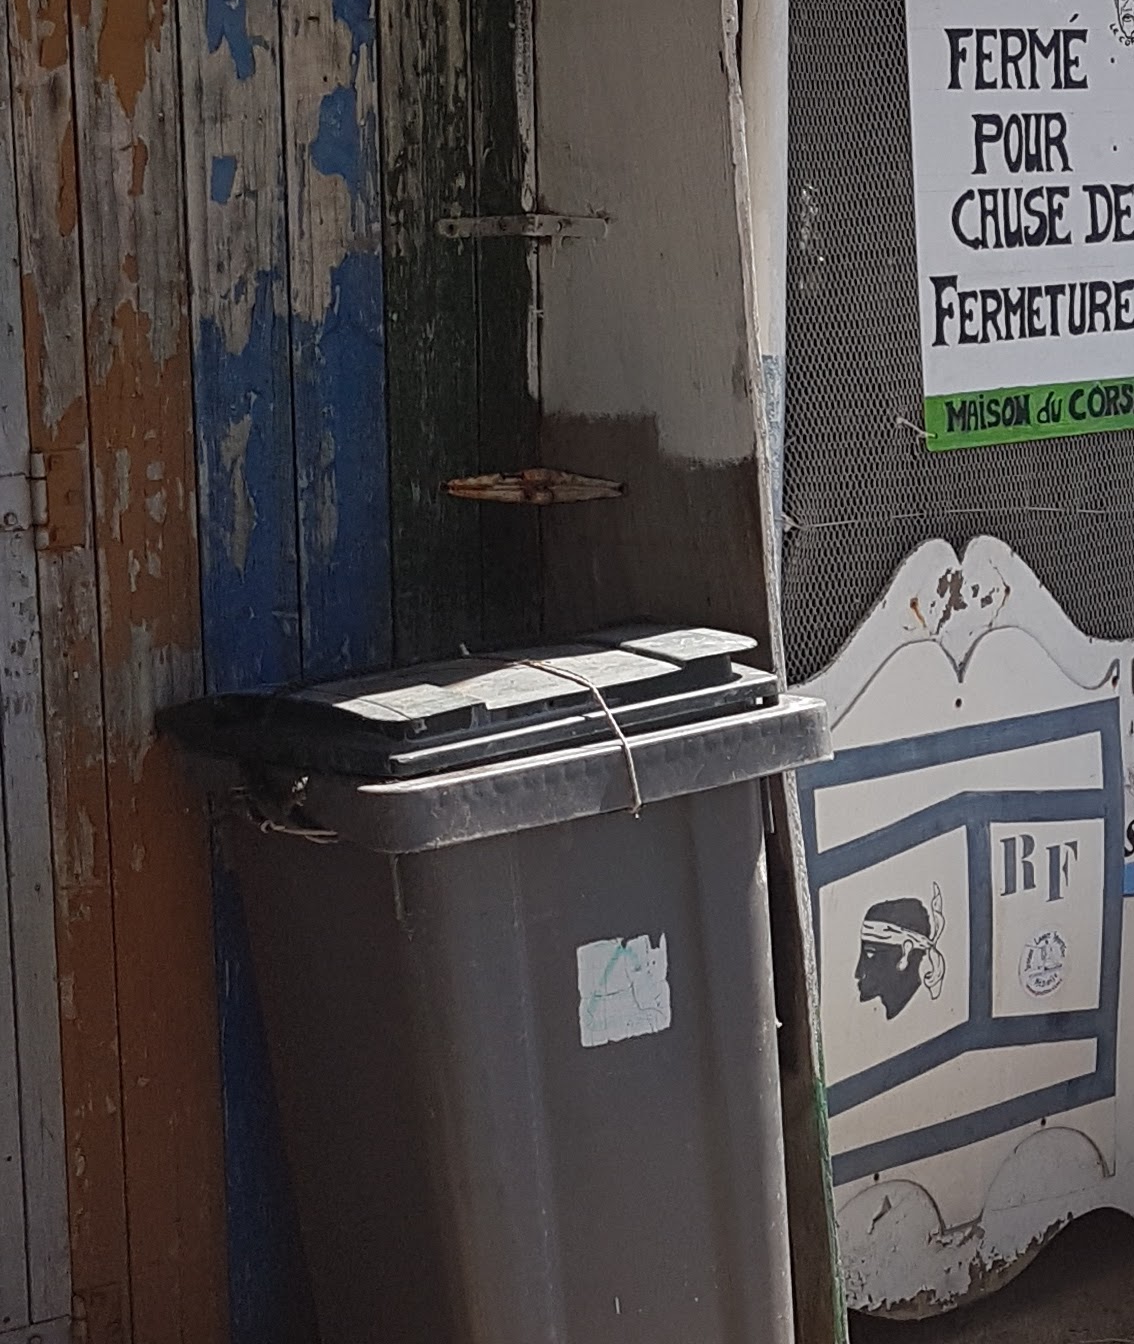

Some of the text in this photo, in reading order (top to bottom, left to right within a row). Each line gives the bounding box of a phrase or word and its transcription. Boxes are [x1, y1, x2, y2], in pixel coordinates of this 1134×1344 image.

[943, 13, 1089, 90] FERMÉ
[971, 112, 1075, 175] POUR
[951, 185, 1073, 250] CAUSE
[1036, 390, 1063, 425] du
